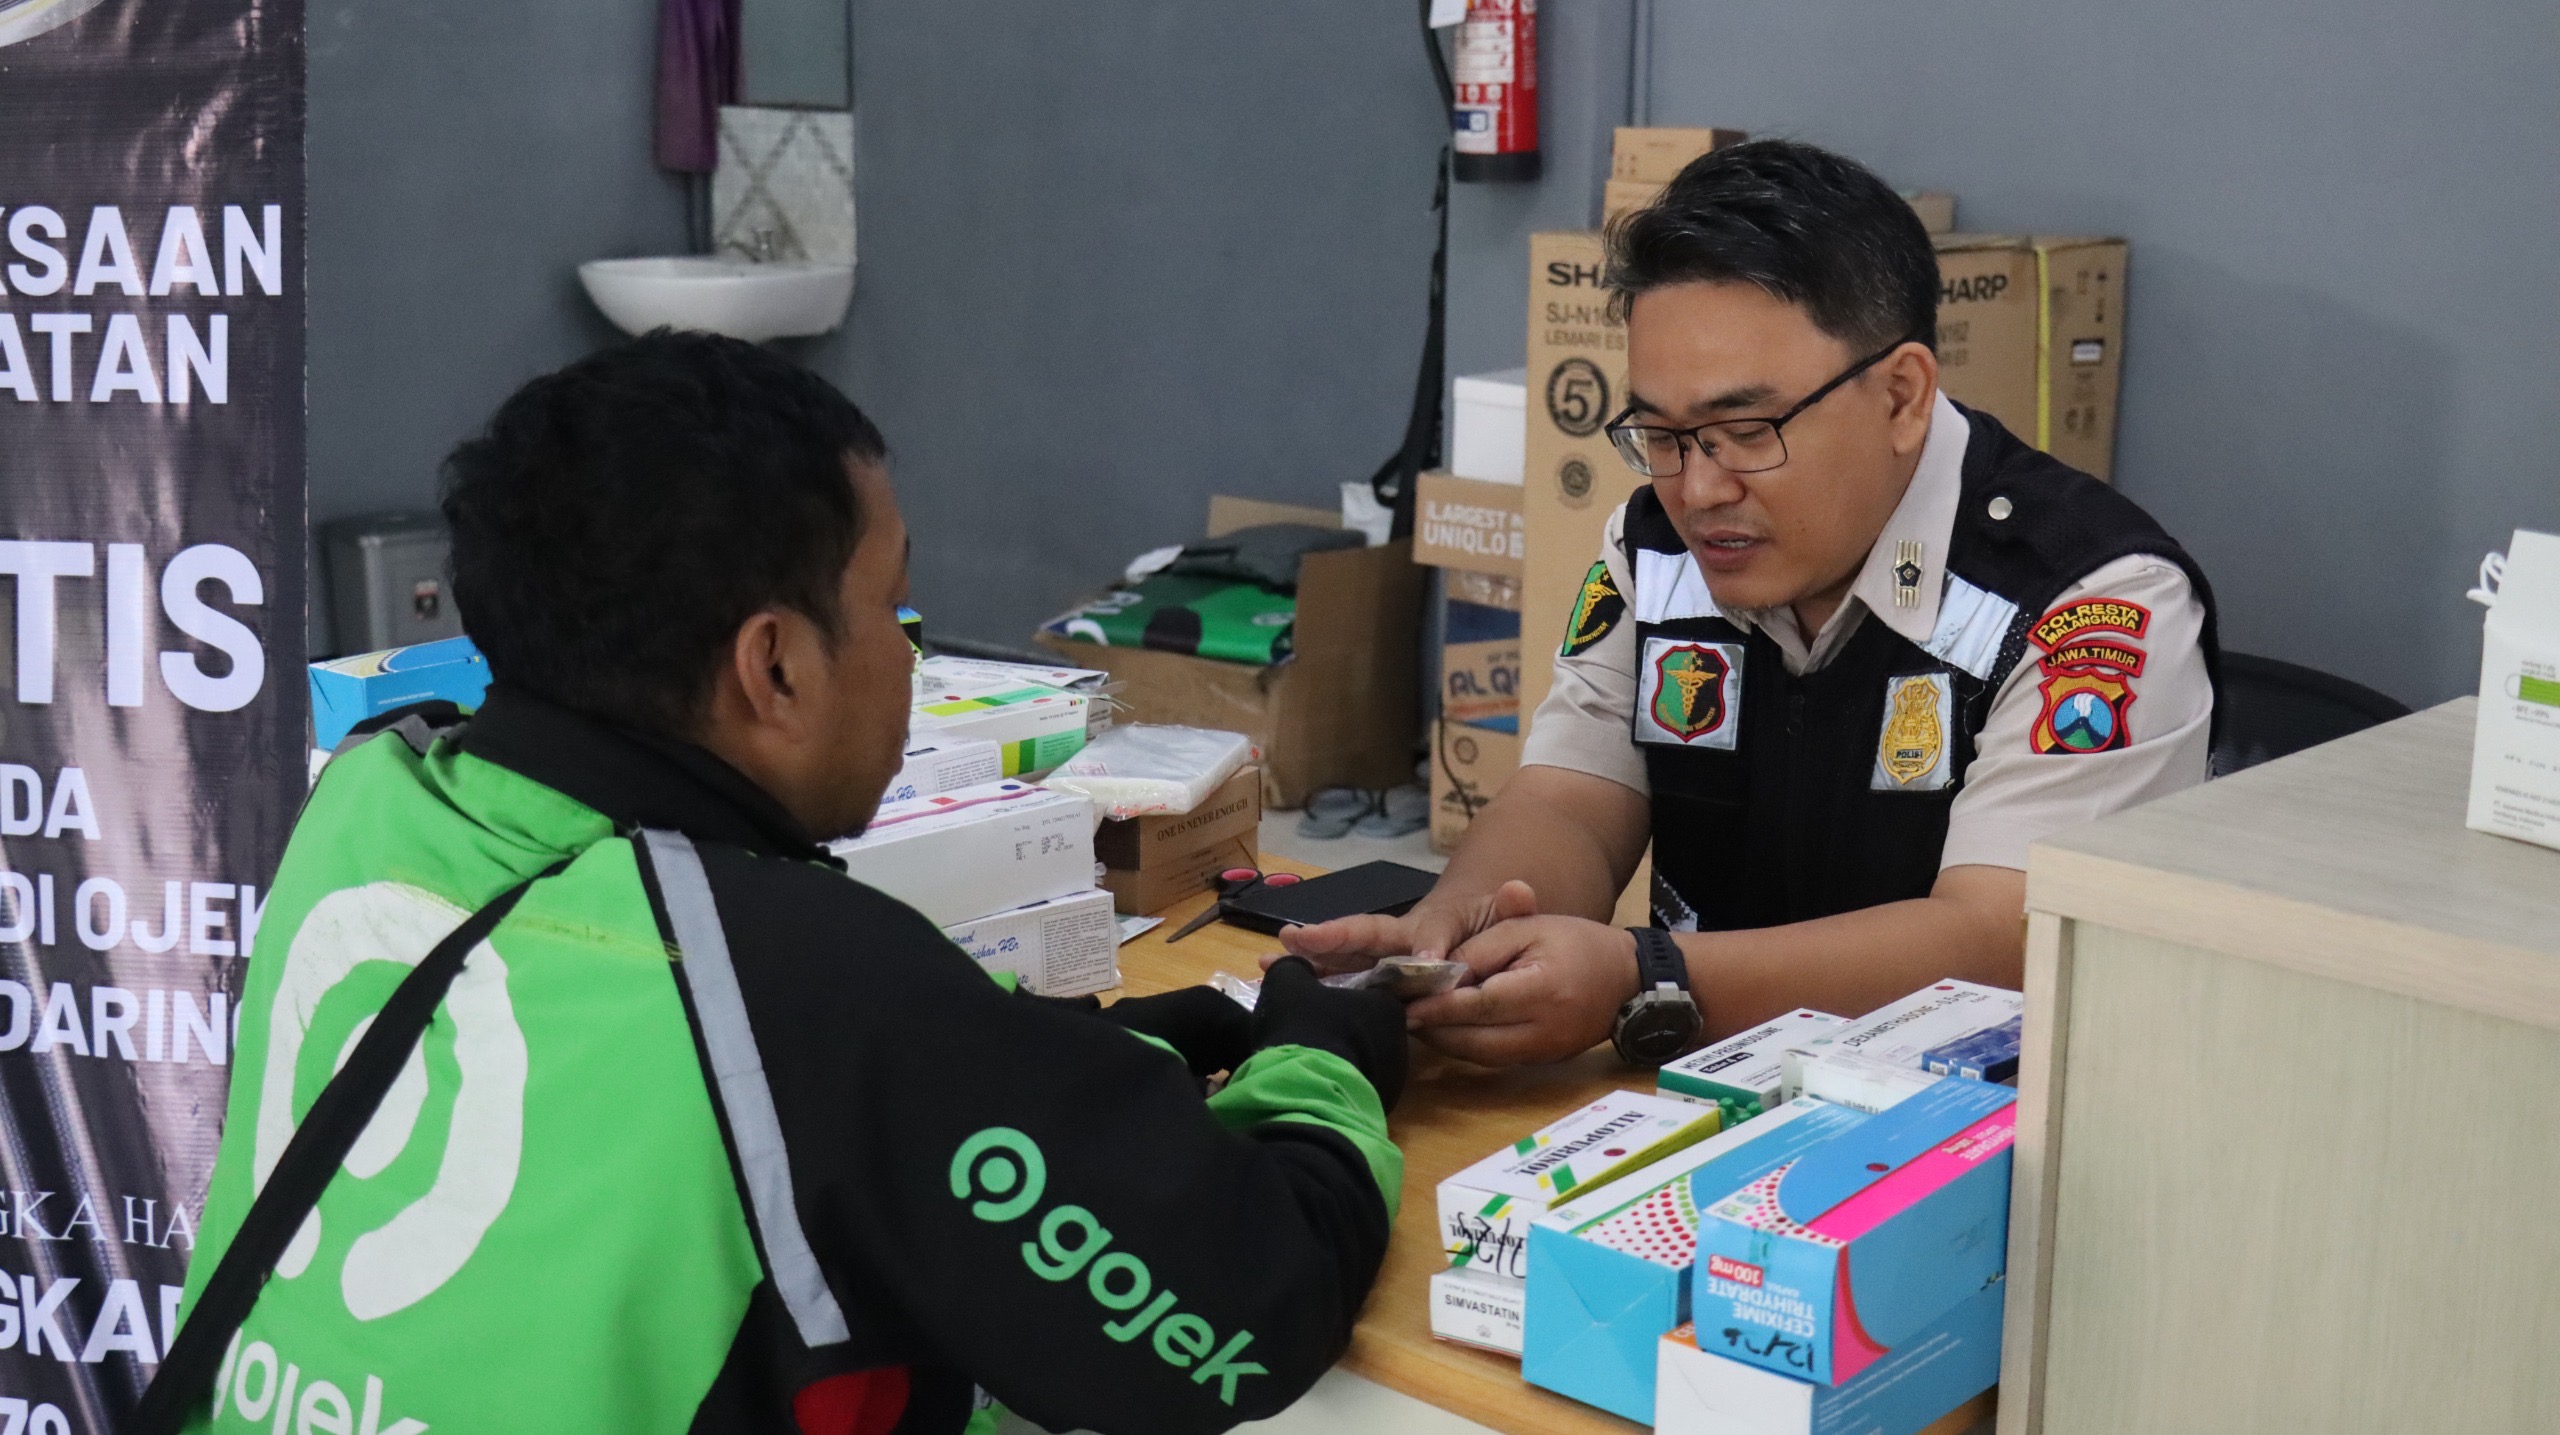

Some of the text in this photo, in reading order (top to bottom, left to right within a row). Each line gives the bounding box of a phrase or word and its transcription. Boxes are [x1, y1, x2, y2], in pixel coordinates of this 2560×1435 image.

[0, 204, 282, 296] SAAN
[1422, 521, 1506, 557] UNIQLO
[2037, 603, 2139, 639] POLRESTA
[2046, 614, 2137, 645] MALANGKOTA
[2048, 648, 2137, 668] JAWA TIMUR
[1157, 825, 1177, 842] ONE
[1177, 822, 1186, 834] IS
[1186, 811, 1214, 830] NEVER
[0, 871, 56, 946] DI
[0, 979, 243, 1066] DARIN
[1513, 1110, 1647, 1177] ALLOPURINOL
[0, 1190, 109, 1241] KA
[1021, 1204, 1270, 1406] gojek
[1445, 1294, 1520, 1321] SIMVASTATIN
[1707, 1277, 1816, 1320] TRIHYDRATE
[1732, 1302, 1815, 1339] CEFIXIME
